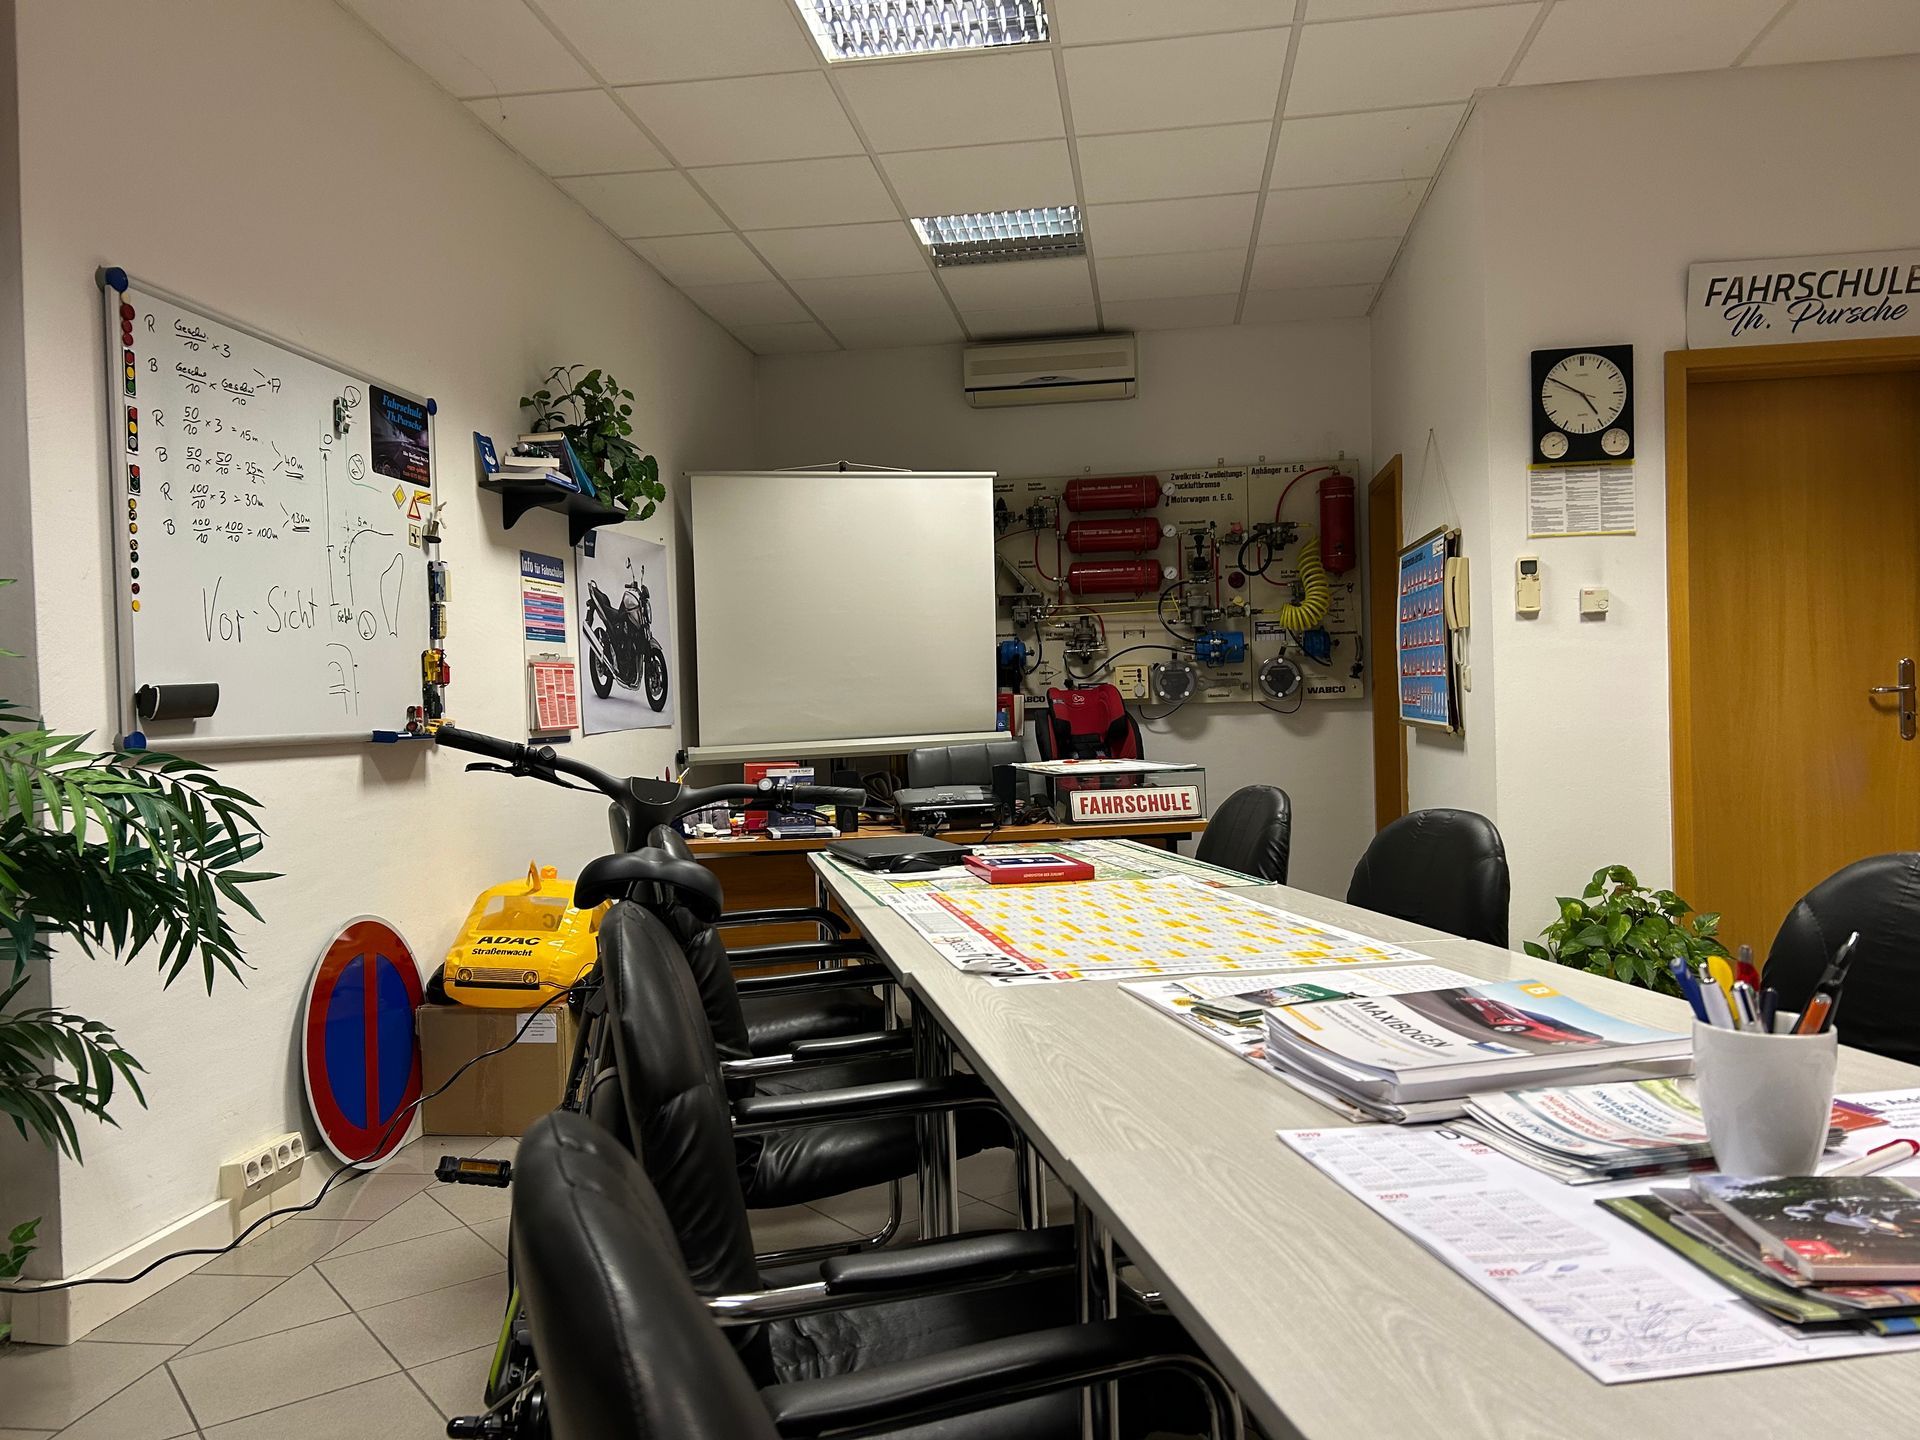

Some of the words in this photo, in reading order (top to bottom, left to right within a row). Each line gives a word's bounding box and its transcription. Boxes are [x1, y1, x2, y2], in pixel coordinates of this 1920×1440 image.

[1705, 264, 1920, 307] FAHRSCHULE
[1724, 302, 1771, 337] Th.
[1787, 296, 1909, 334] Pursche
[220, 343, 231, 359] 3
[382, 394, 423, 419] Fahrschule
[184, 406, 199, 420] 50
[214, 418, 223, 433] 3
[186, 446, 202, 458] 50
[215, 451, 233, 463] 50
[1251, 466, 1282, 476] Anhänger
[1174, 481, 1221, 491] ruckluftbremse
[189, 483, 209, 494] 100
[219, 490, 227, 505] 3
[1170, 494, 1210, 504] Motorwagen
[192, 518, 211, 527] 100
[225, 521, 244, 531] 100
[521, 556, 534, 573] Info
[1306, 685, 1346, 695] WABCO
[1079, 792, 1192, 816] FAHRSCHULE
[476, 936, 542, 946] ADAC
[471, 947, 533, 957] Straßenwacht
[1352, 1000, 1454, 1049] MAXIBOGEN
[1295, 1131, 1322, 1139] 2019
[1377, 1192, 1409, 1200] 2020
[1485, 1267, 1520, 1278] 2021
